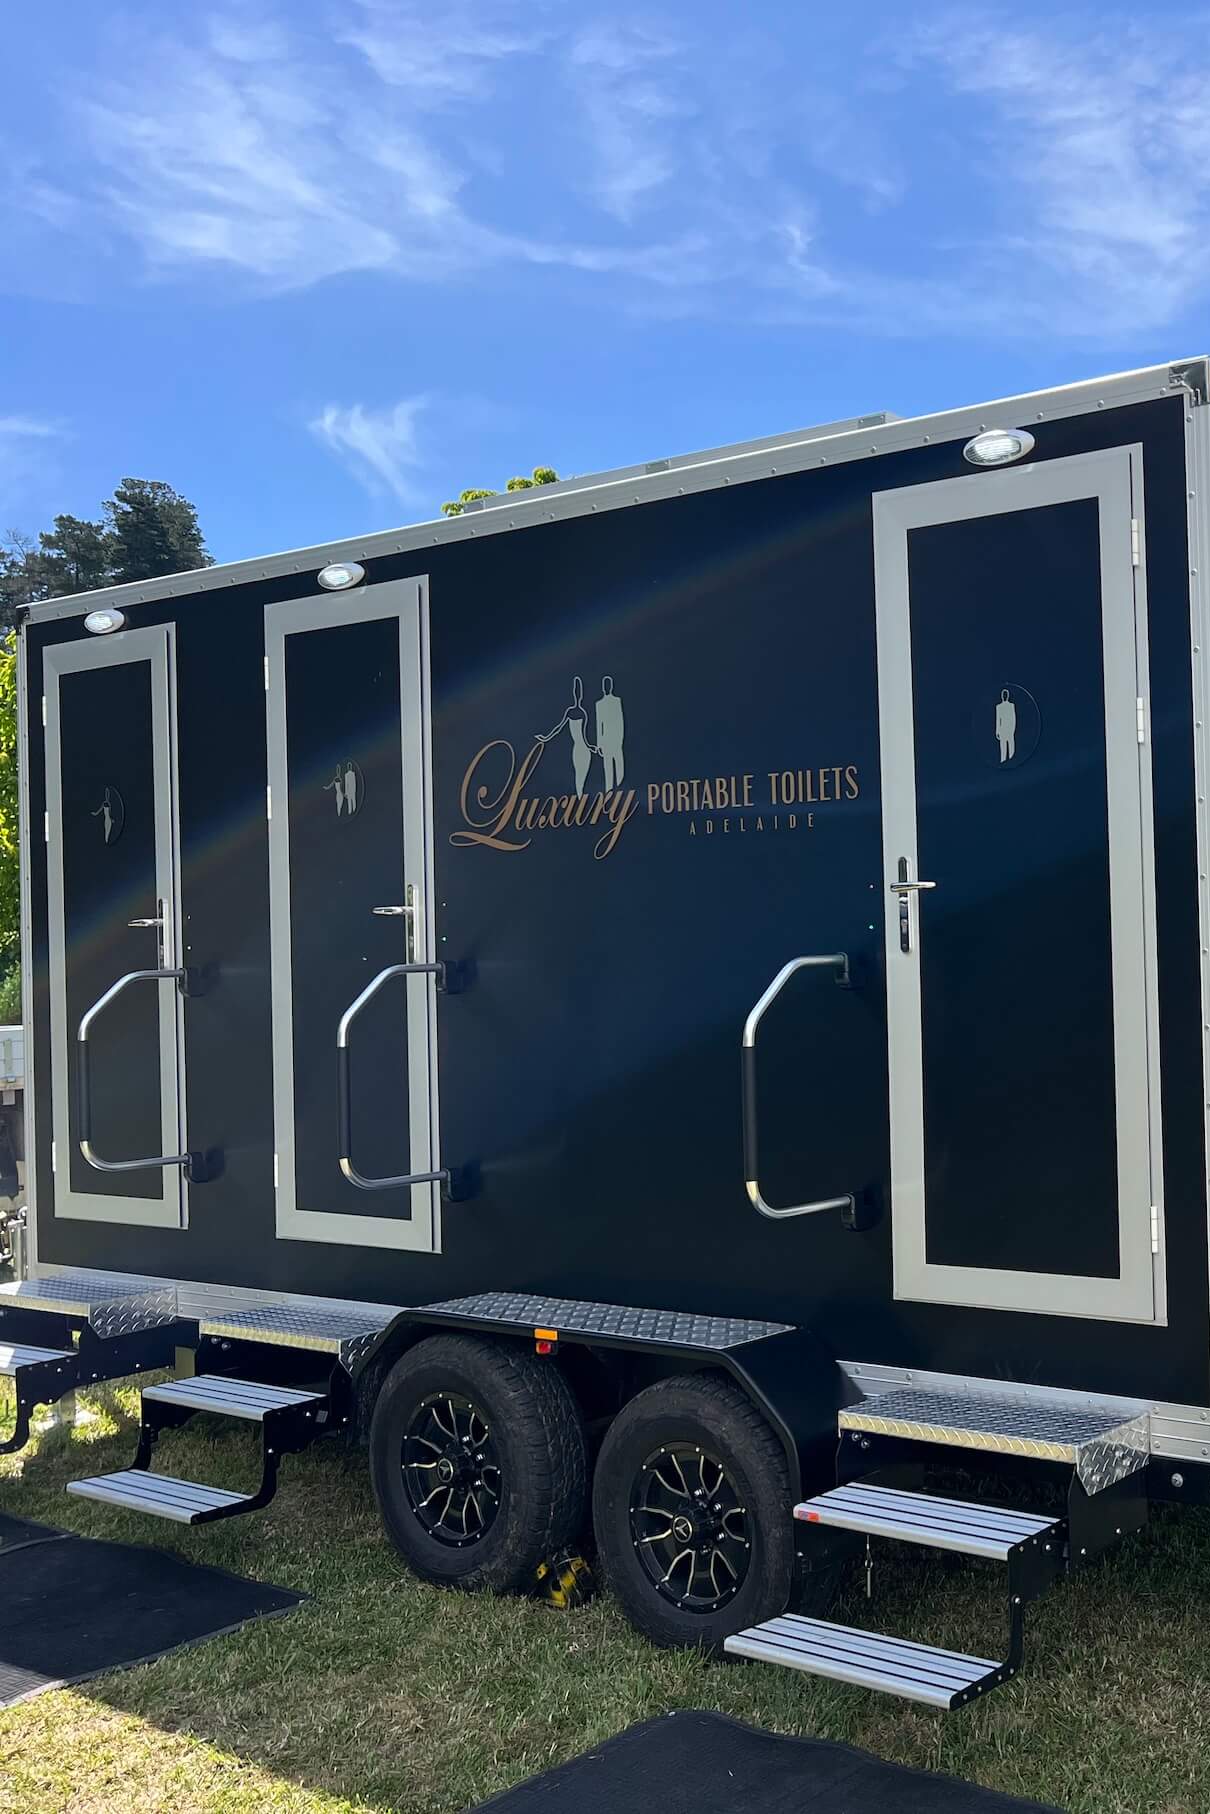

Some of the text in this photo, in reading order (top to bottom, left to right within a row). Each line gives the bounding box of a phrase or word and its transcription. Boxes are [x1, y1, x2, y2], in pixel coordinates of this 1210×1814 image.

[448, 740, 860, 860] Luxury PORTABLE TOILETS
[689, 812, 815, 836] ADELAIDE
